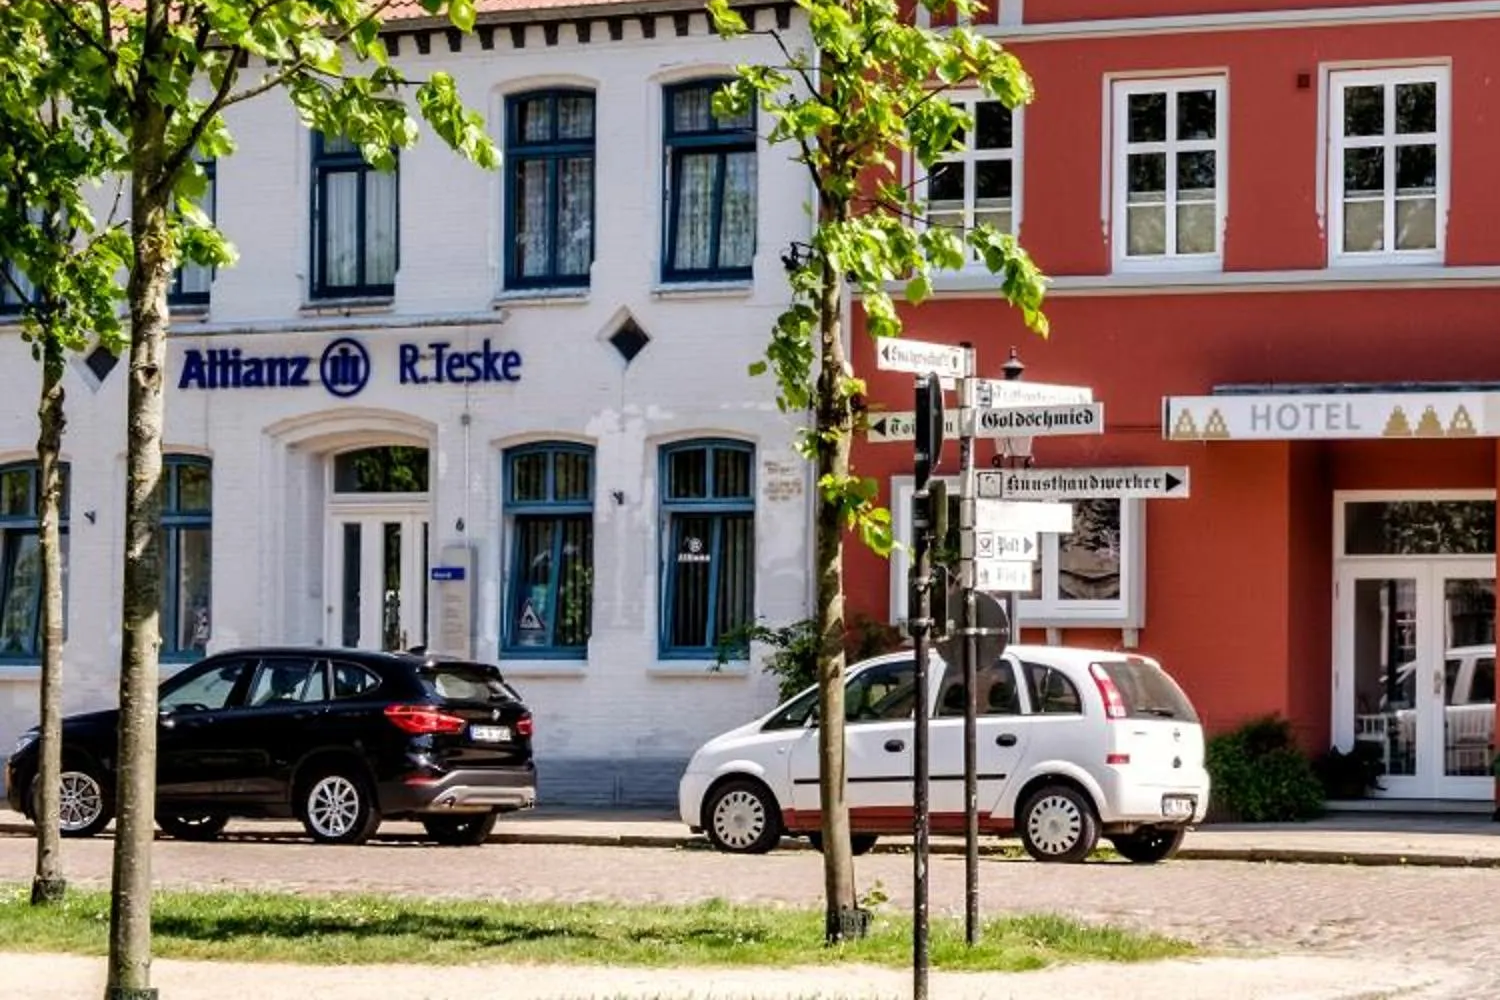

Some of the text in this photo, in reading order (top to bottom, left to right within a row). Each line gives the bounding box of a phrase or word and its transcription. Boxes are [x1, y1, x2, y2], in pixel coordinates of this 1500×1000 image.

[178, 348, 311, 389] Allianz
[980, 407, 1094, 431] Goldschmied
[1250, 401, 1361, 432] HOTEL
[1005, 473, 1162, 495] Kunsthandwerker
